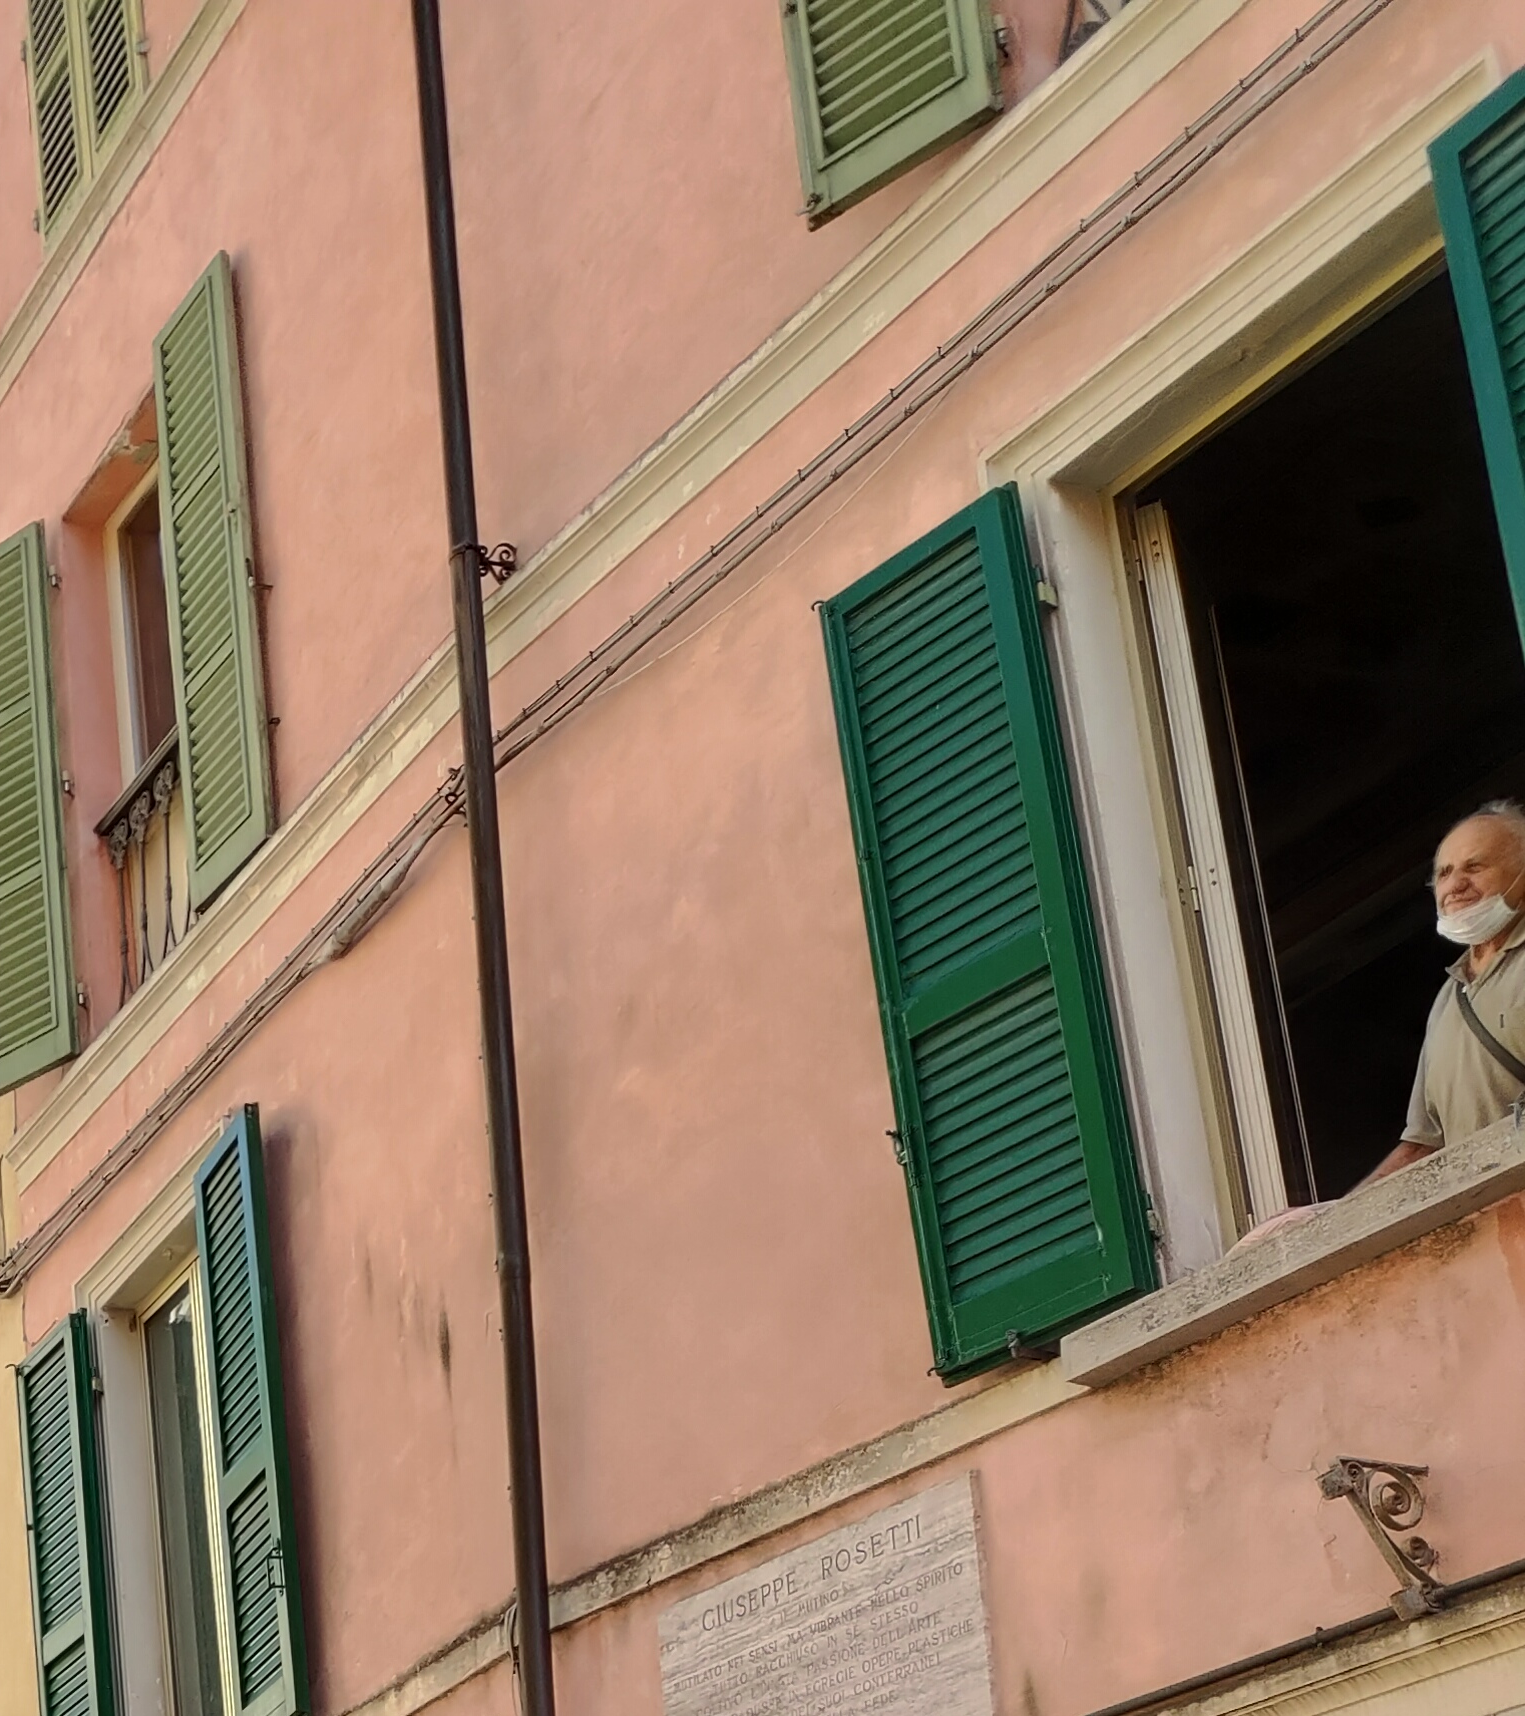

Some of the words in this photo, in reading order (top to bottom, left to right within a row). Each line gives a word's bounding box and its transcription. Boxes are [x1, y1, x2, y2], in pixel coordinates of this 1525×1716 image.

[701, 1569, 798, 1634] GIUSEPPE
[820, 1513, 922, 1581] ROSETTI
[748, 1639, 778, 1663] SENSI
[809, 1604, 861, 1638] VIBRANTE
[915, 1560, 963, 1593] SPIRITO
[755, 1641, 818, 1679] RACCHIUSO
[869, 1599, 919, 1632] STESSO
[805, 1665, 855, 1696] EGREGIE
[861, 1646, 901, 1674] OPERE
[908, 1616, 974, 1656] PLASTICHE
[805, 1641, 864, 1677] PASSIONE
[853, 1651, 940, 1698] CONTERRANEI
